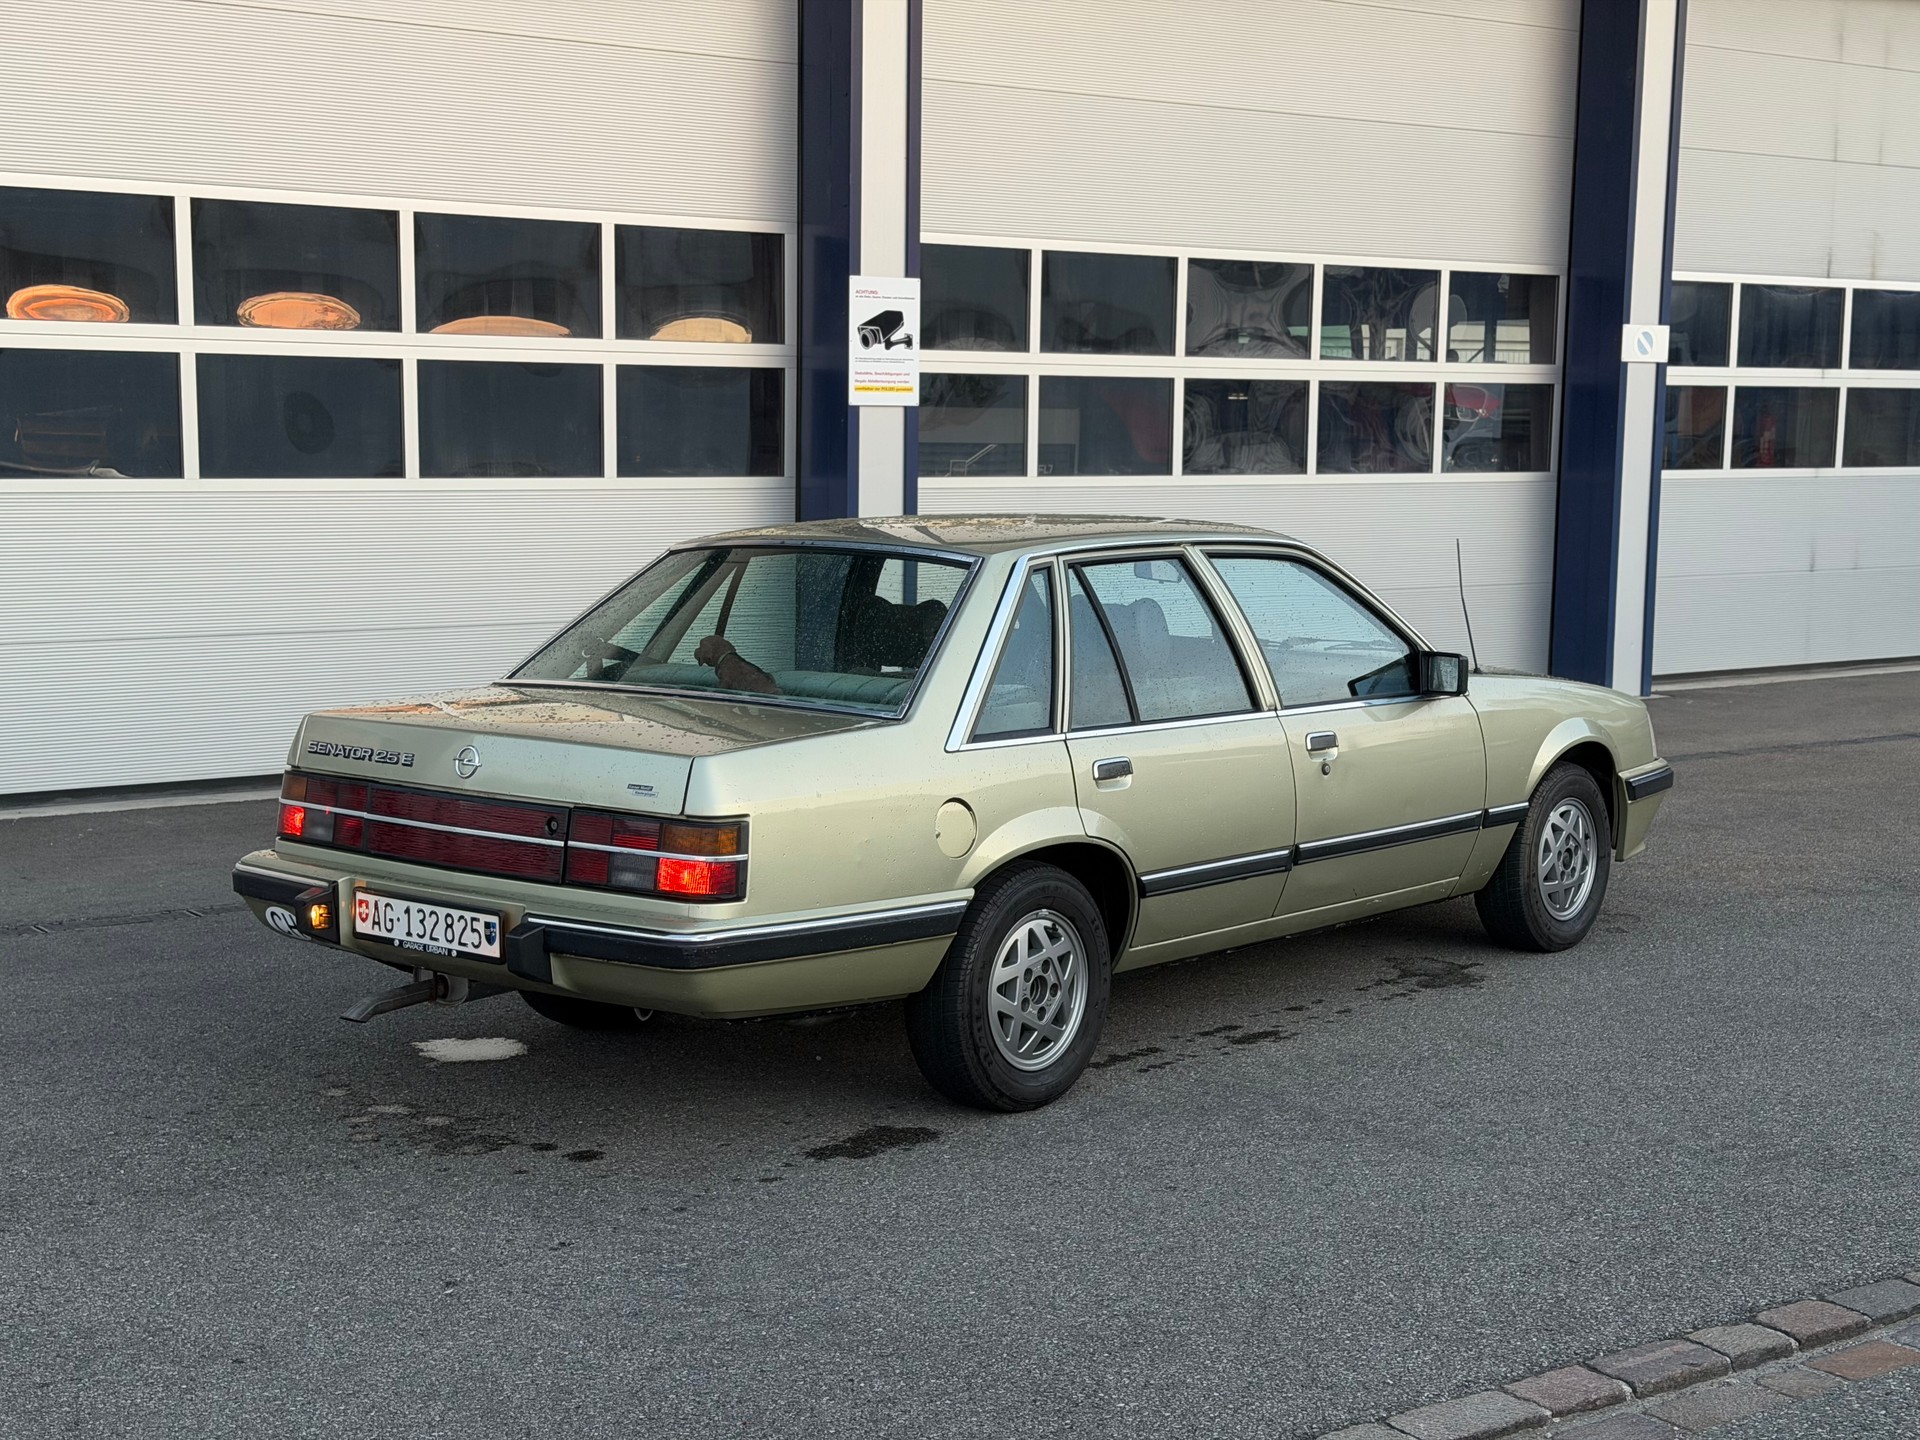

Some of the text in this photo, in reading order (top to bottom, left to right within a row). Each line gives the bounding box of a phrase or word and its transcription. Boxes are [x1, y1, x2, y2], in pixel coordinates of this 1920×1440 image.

[307, 740, 373, 762] SENATOR
[401, 752, 416, 768] E
[270, 910, 308, 939] CH
[402, 940, 449, 956] GARAGE URBAN
